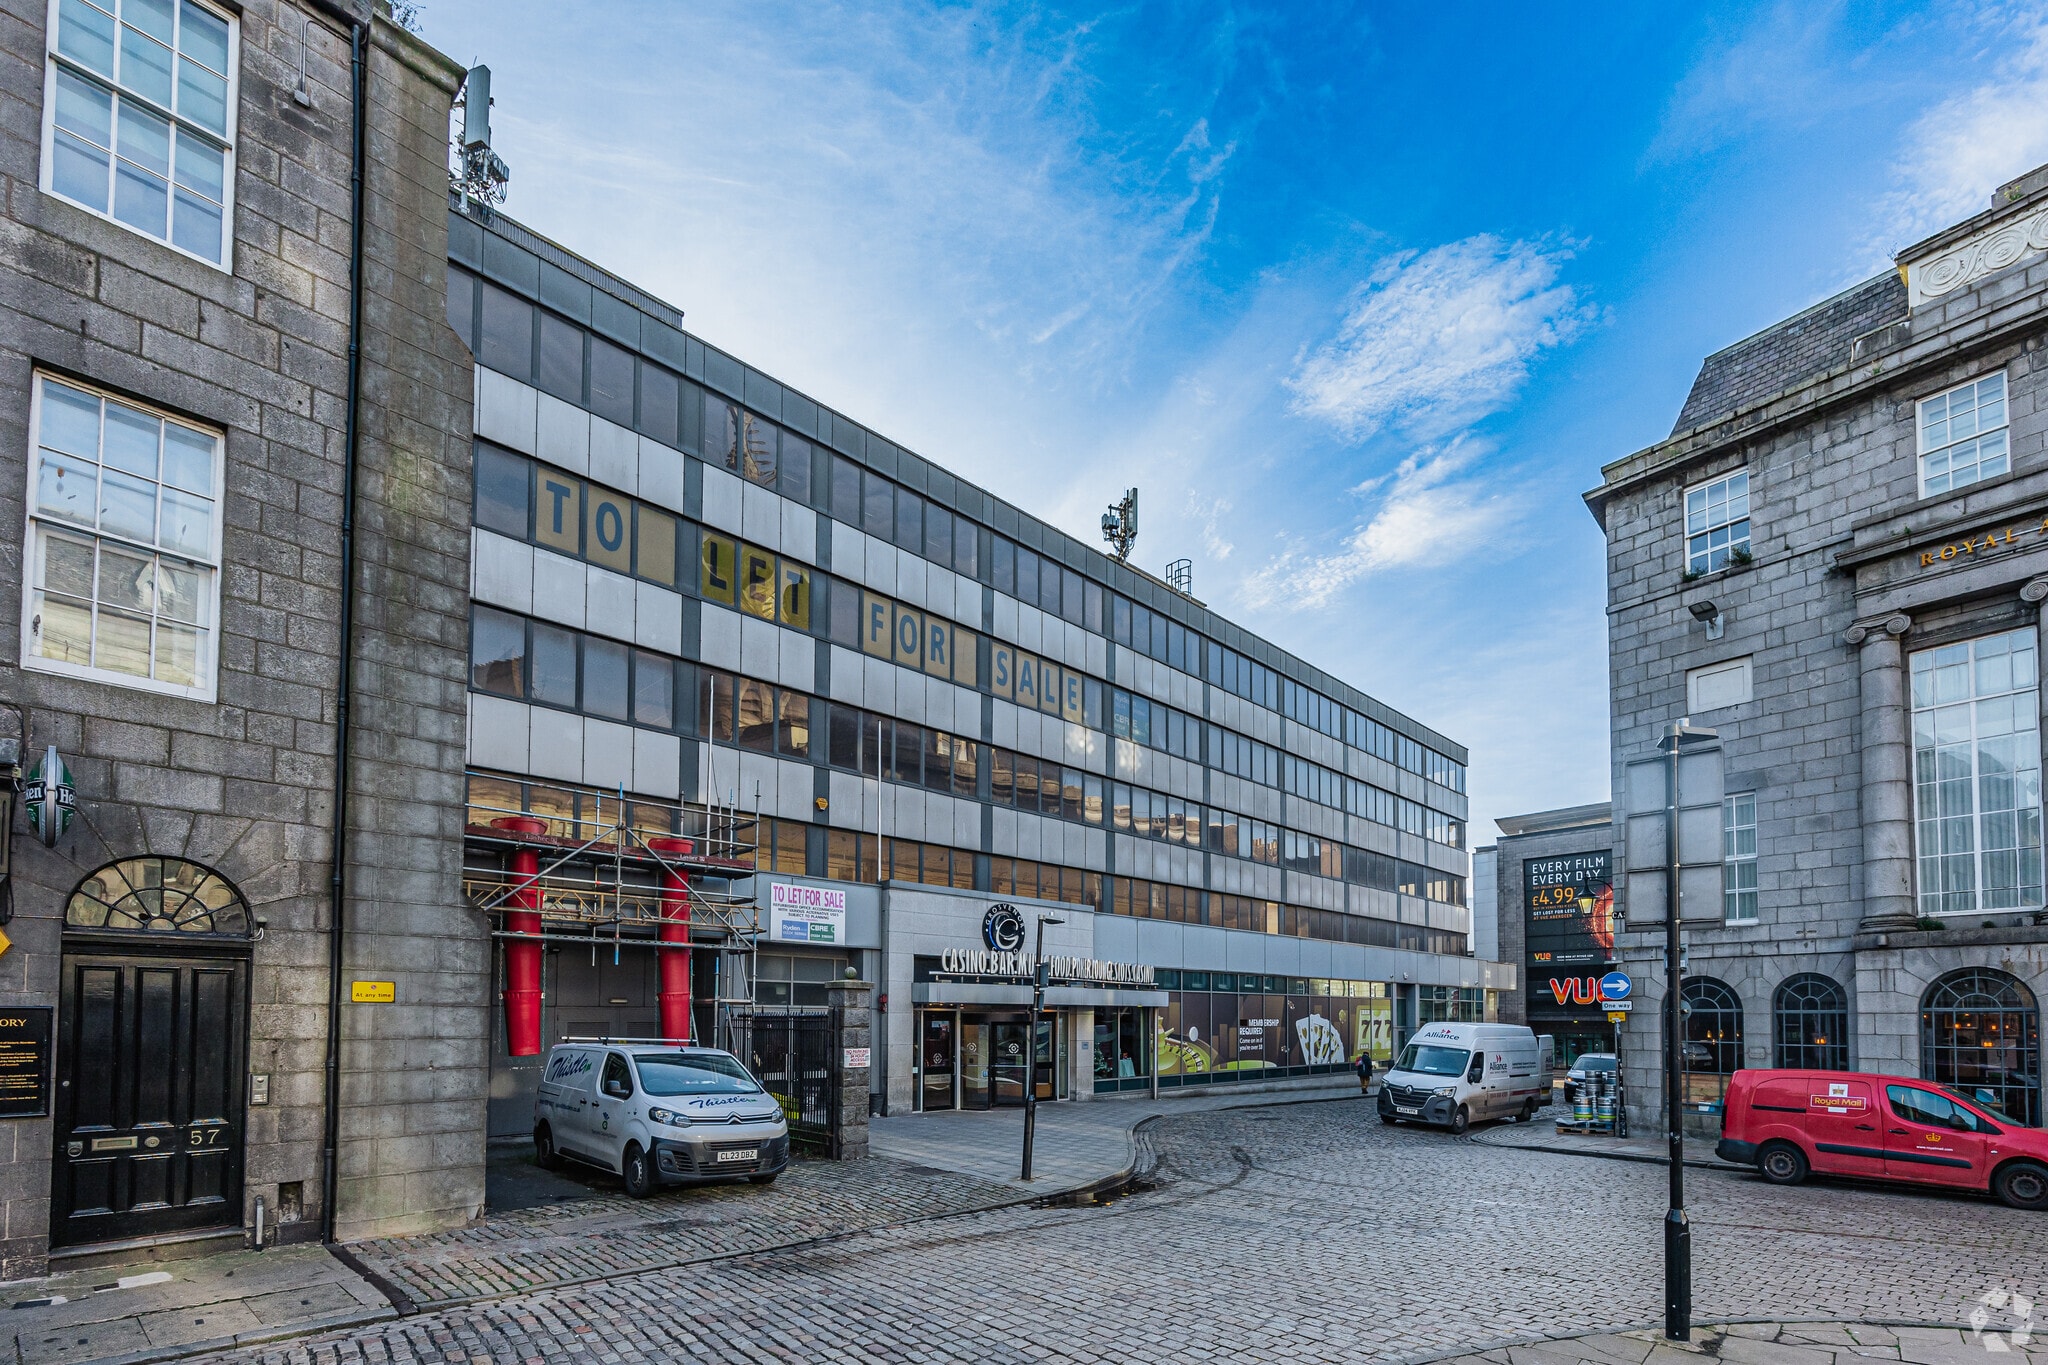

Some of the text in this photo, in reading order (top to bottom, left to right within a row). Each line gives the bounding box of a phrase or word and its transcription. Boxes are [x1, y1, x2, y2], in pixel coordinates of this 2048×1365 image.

[1921, 528, 2019, 567] ROYAL
[546, 480, 1077, 712] TO LET FOR SALE
[1532, 856, 1604, 874] EVERY FILM
[1532, 869, 1600, 886] EVERY DAY
[773, 886, 784, 902] TO
[824, 891, 844, 909] SALE
[985, 904, 1025, 928] GROSVENOR
[810, 924, 829, 932] CBRE
[1248, 1018, 1280, 1027] MEMBERSHIP
[1239, 1027, 1263, 1035] REQUIRED
[1424, 1031, 1460, 1041] Alliance
[552, 1052, 588, 1082] Thistle
[1489, 1062, 1508, 1071] Alliance
[688, 1094, 748, 1109] Thistle
[1814, 1096, 1862, 1107] Royal Mail
[190, 1129, 220, 1145] 57
[720, 1150, 755, 1160] CL23 DBZ
